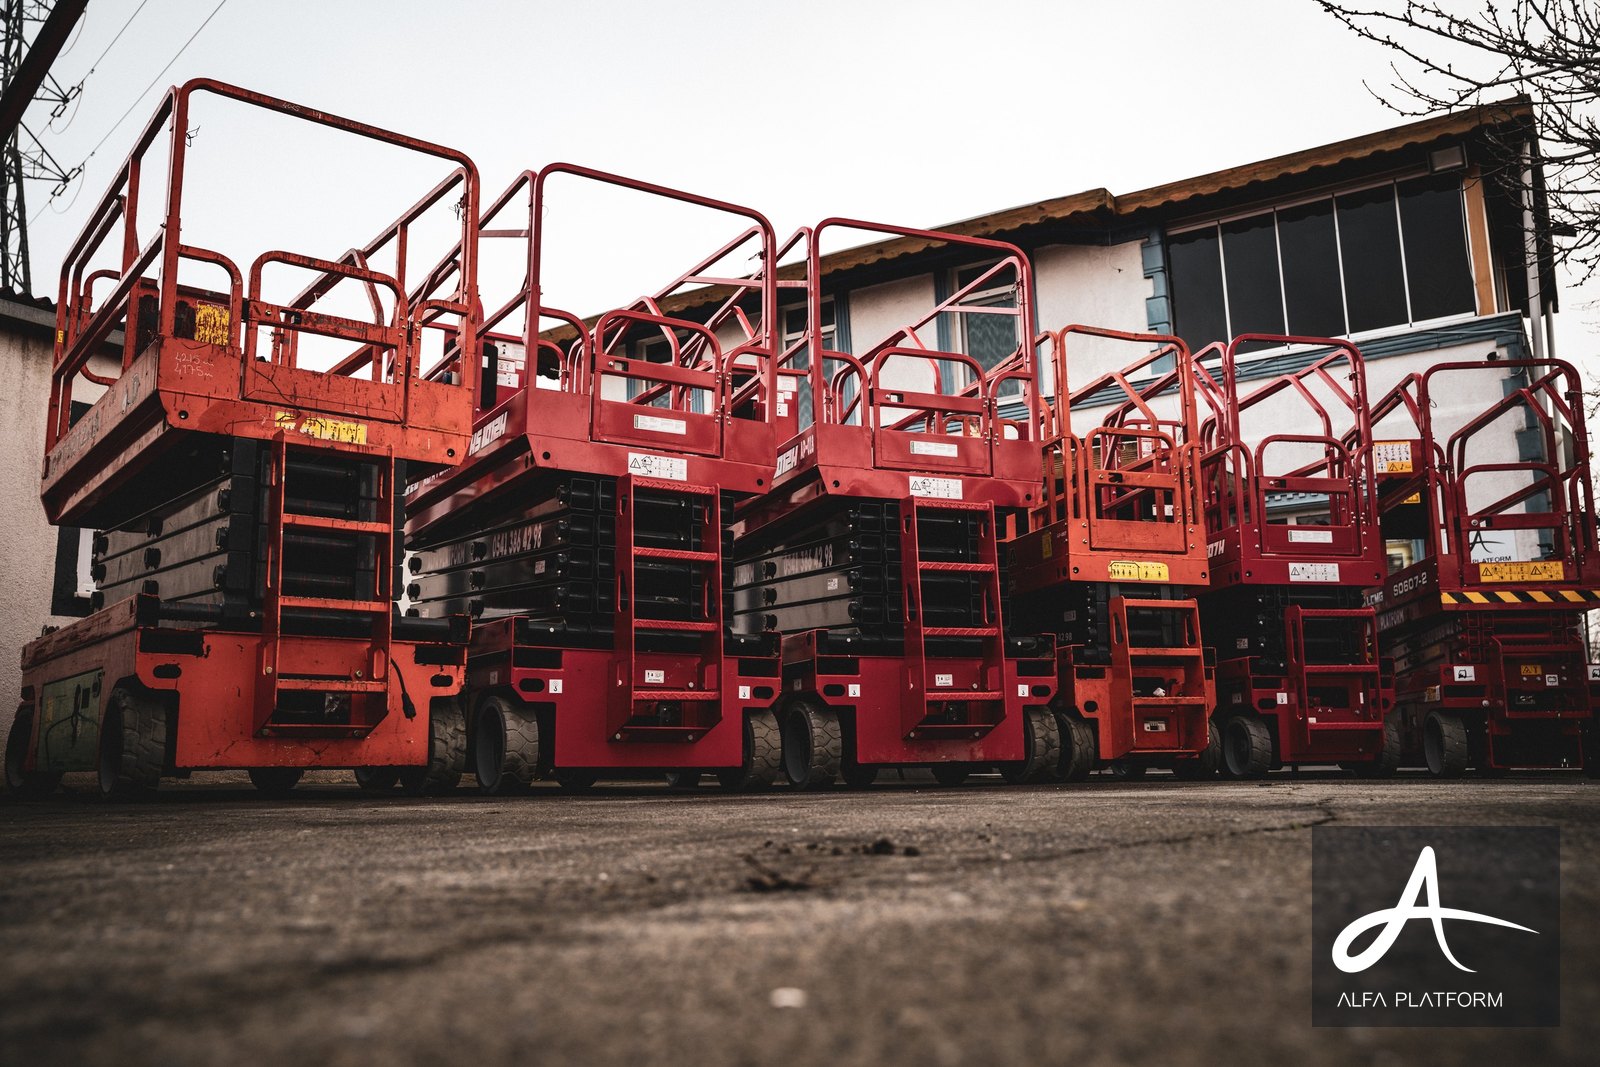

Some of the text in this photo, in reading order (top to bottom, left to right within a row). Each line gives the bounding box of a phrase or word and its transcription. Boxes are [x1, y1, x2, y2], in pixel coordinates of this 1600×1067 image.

[522, 525, 532, 551] 42
[533, 522, 543, 550] 98
[824, 543, 834, 567] 98
[1206, 539, 1226, 559] 07H
